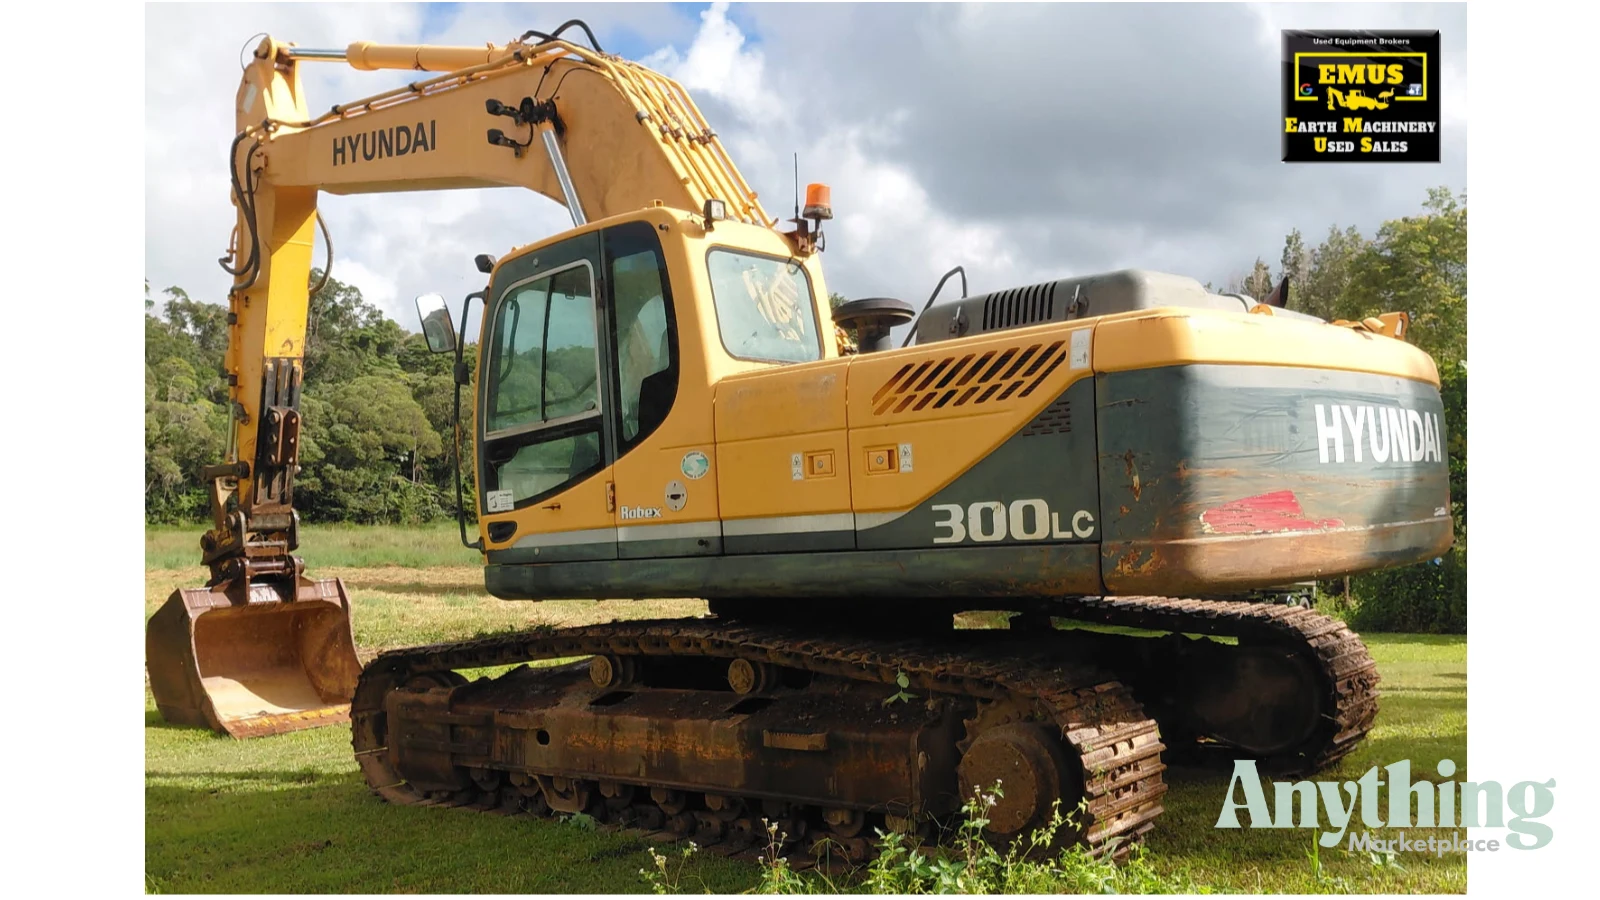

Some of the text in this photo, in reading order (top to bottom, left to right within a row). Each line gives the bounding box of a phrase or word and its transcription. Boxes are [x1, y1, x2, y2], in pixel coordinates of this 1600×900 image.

[333, 120, 436, 166] HYUNDAI
[1314, 404, 1442, 464] HYUNDAI
[620, 505, 662, 519] Robex
